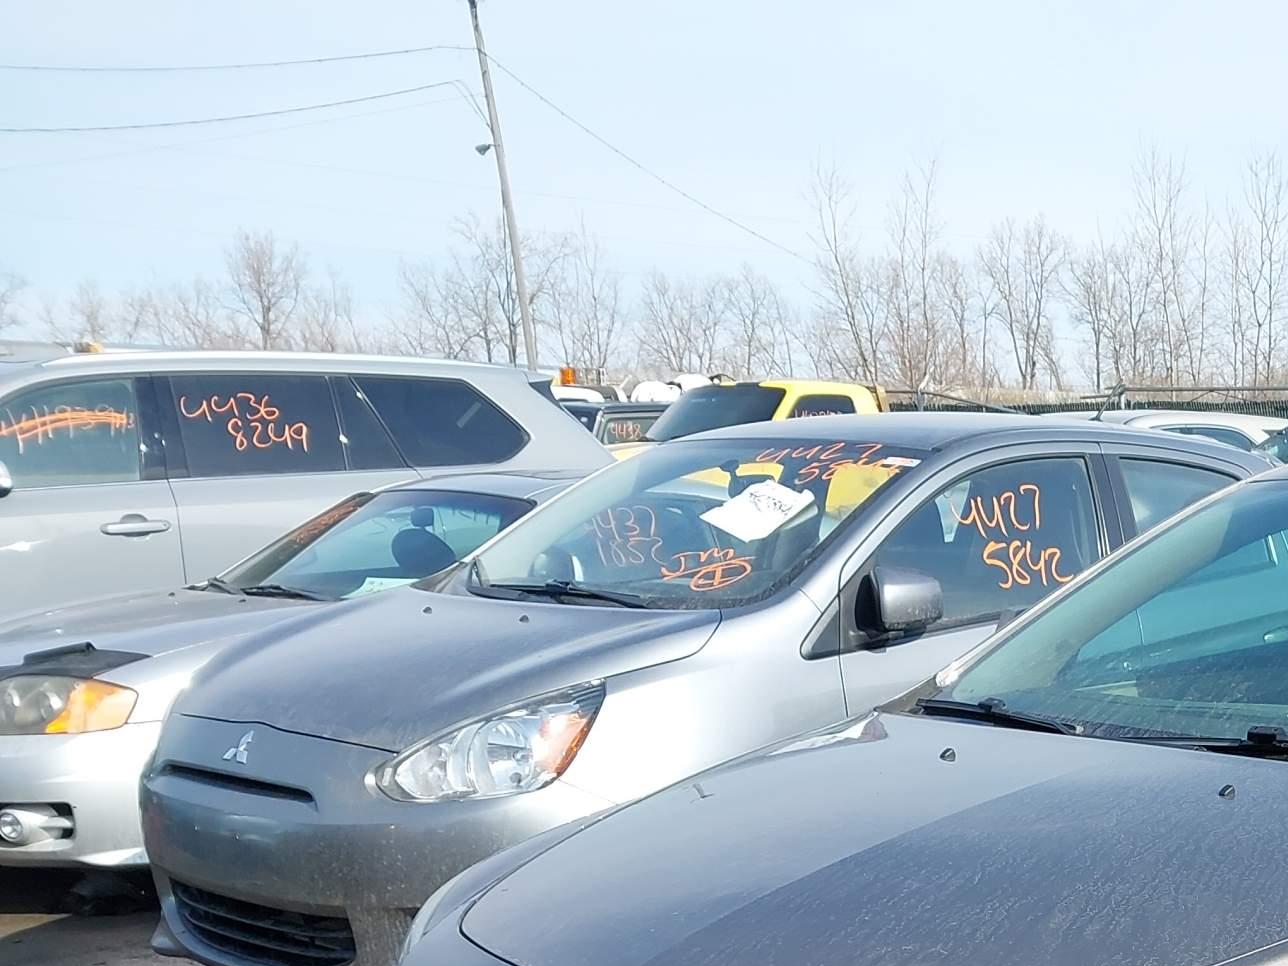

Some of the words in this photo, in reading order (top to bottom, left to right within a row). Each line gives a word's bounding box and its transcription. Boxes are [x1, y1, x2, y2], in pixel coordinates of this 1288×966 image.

[180, 393, 279, 422] 4436
[227, 417, 308, 452] 8249
[755, 442, 883, 462] 4427
[951, 484, 1040, 538] 4427
[983, 540, 1074, 588] 5842
